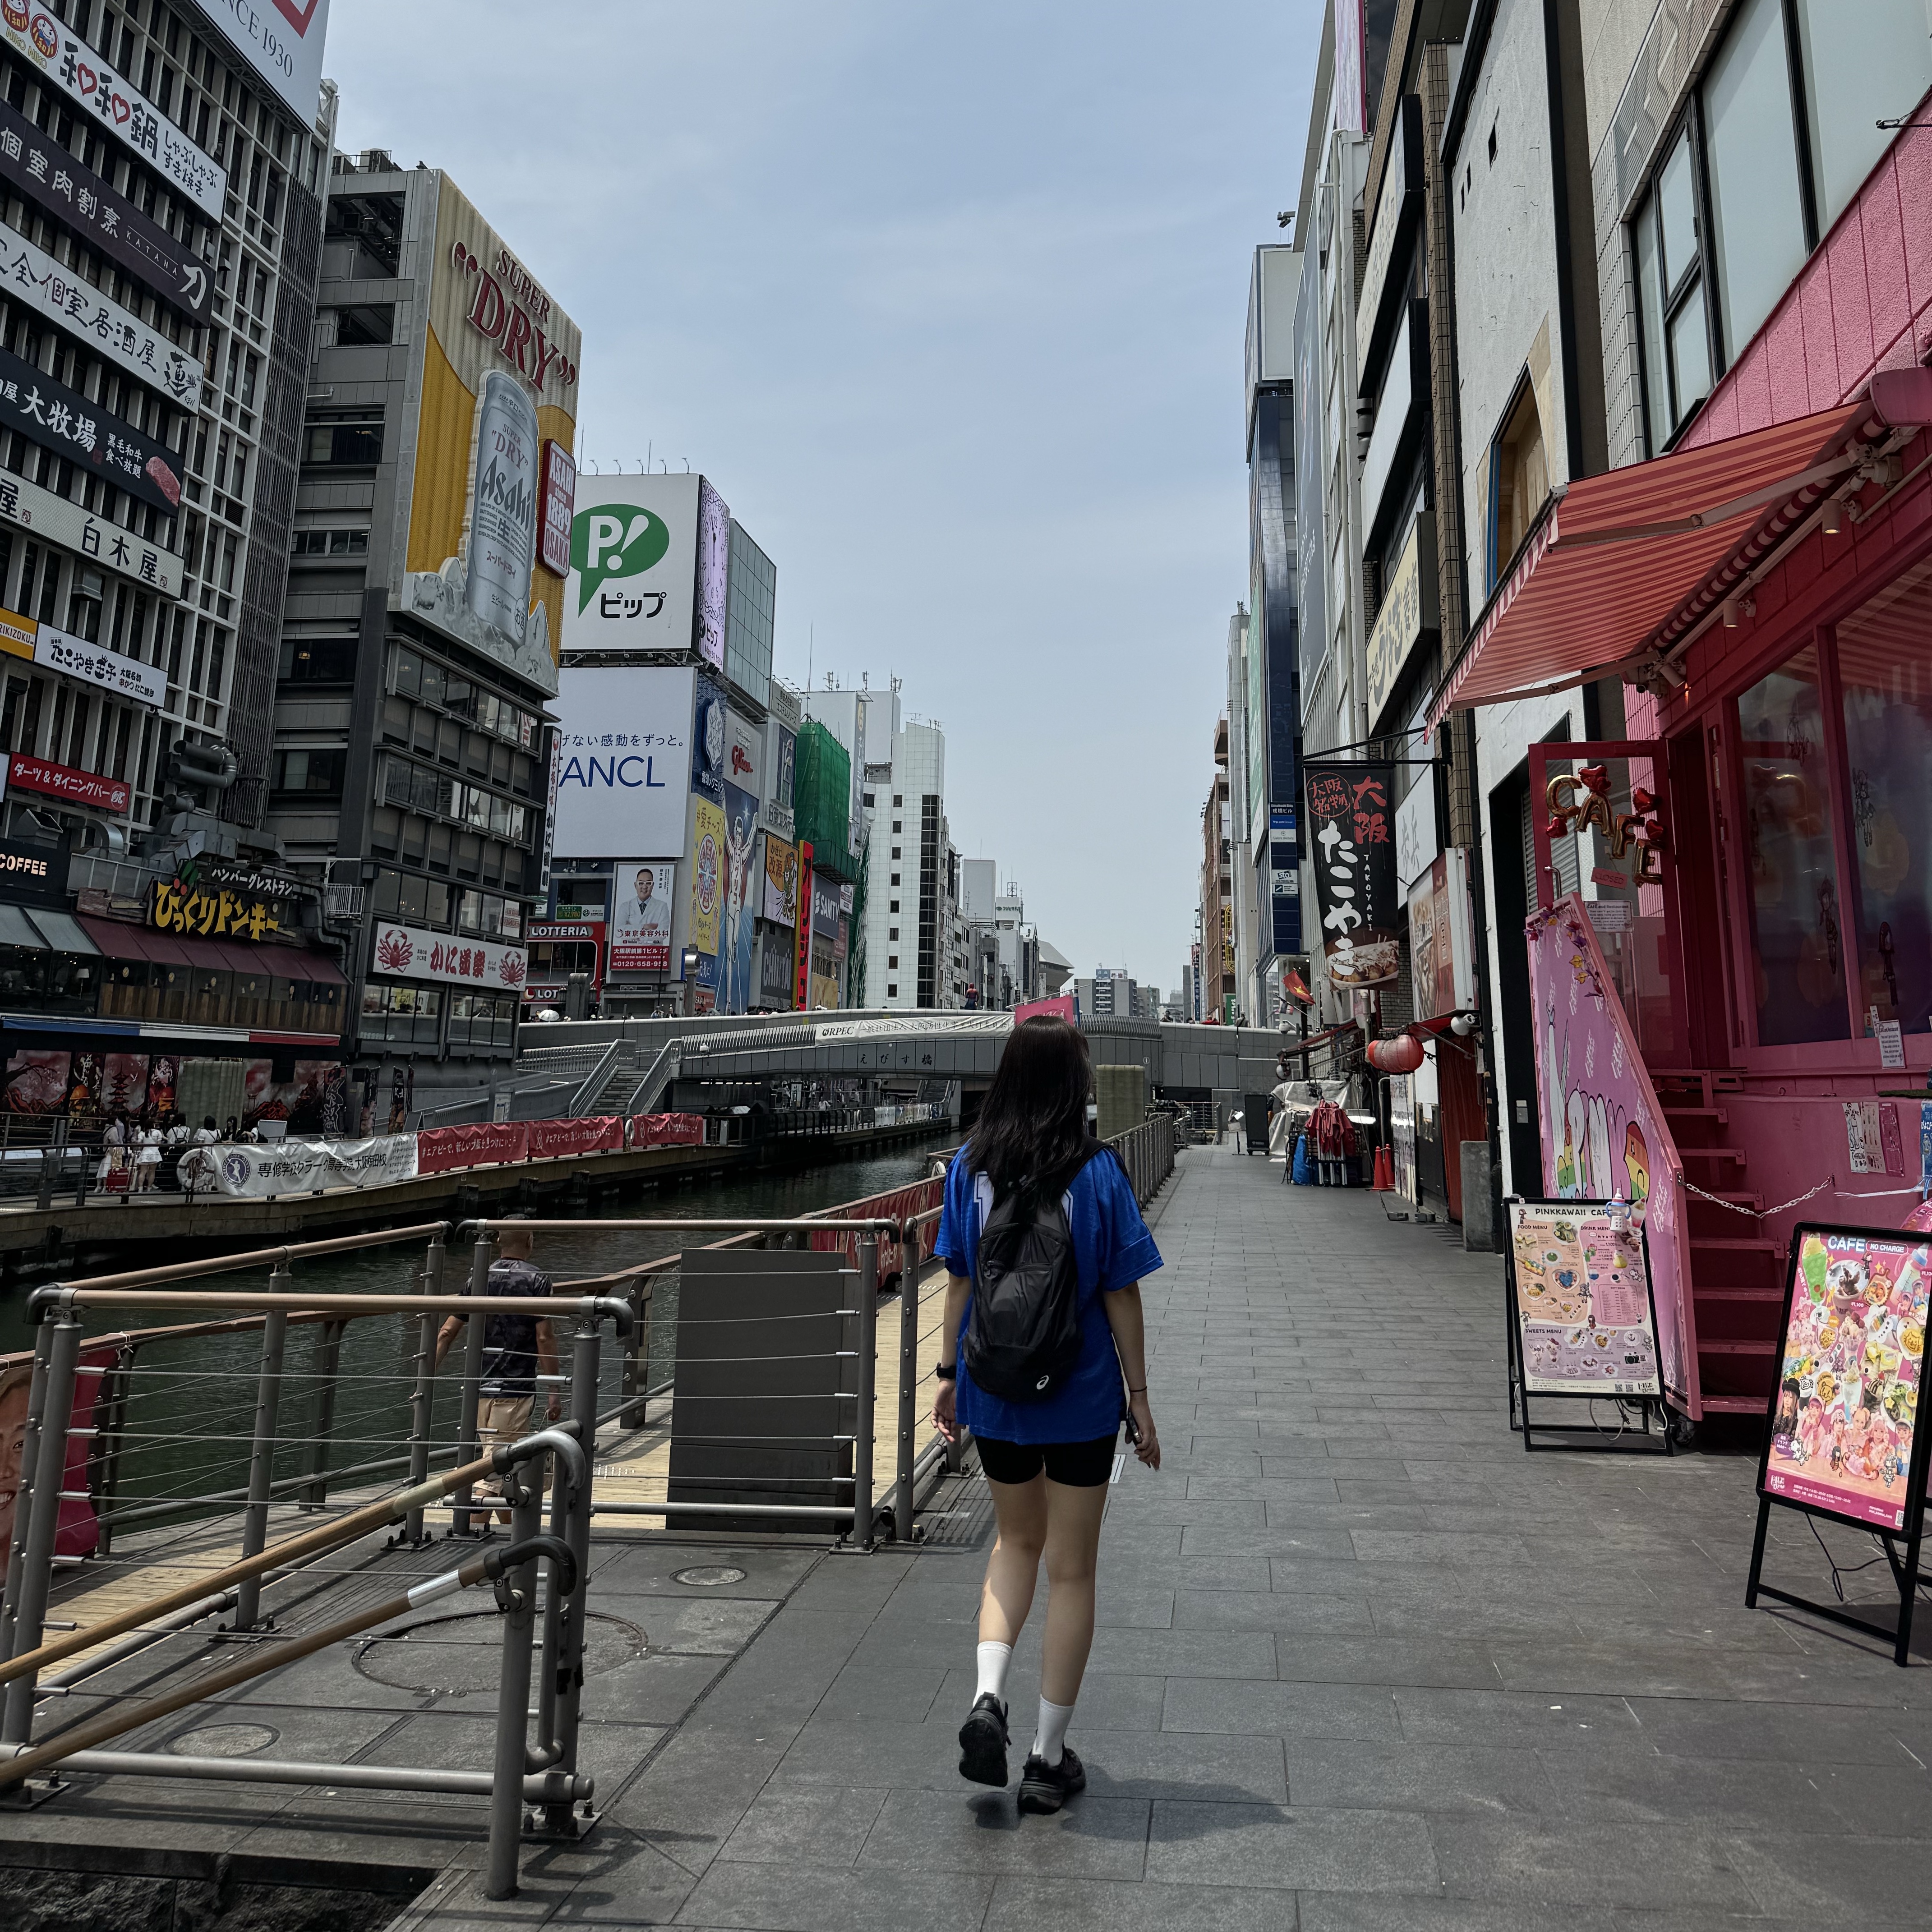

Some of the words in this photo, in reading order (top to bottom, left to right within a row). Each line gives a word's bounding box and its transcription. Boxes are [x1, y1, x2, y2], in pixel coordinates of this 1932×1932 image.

[263, 27, 292, 77] 1930
[164, 151, 203, 198] すき焼き
[165, 130, 217, 188] しゃぶしゃぶ
[126, 230, 179, 276] KATANA
[179, 264, 208, 309] 刀
[496, 249, 550, 323] SUPER
[0, 380, 18, 403] 屋
[20, 386, 98, 452] 大牧場
[502, 424, 521, 446] SUPER
[105, 449, 141, 479] 食べ放題
[107, 432, 143, 462] 黒毛和牛
[480, 455, 532, 531] Asahi
[549, 452, 575, 497] ASAHI
[547, 493, 572, 536] 1889
[81, 518, 157, 584] 白木屋
[486, 551, 516, 579] スーパードライ
[544, 527, 568, 570] OSAKA
[600, 591, 667, 619] ピップ
[51, 645, 116, 681] たこやき王子
[1374, 584, 1403, 708] うなぎ
[558, 756, 665, 787] ANCL
[1309, 777, 1343, 798] 大阪
[1314, 794, 1348, 814] 名物
[1353, 776, 1390, 844] 大阪
[1545, 774, 1666, 888] CAFE
[0, 854, 47, 876] COFFEE
[211, 868, 294, 895] ハンバーグレストラン
[1594, 871, 1625, 884] CLOSED
[155, 882, 279, 942] びっくりドンキー
[821, 895, 840, 923] SAMTY
[1318, 820, 1362, 976] たこやき
[1363, 853, 1373, 932] TAKOYAKI
[531, 926, 588, 936] LOTTERIA
[860, 1053, 933, 1065] えびす橋
[1827, 1235, 1866, 1253] CAFE
[1878, 1244, 1905, 1253] CHARGE
